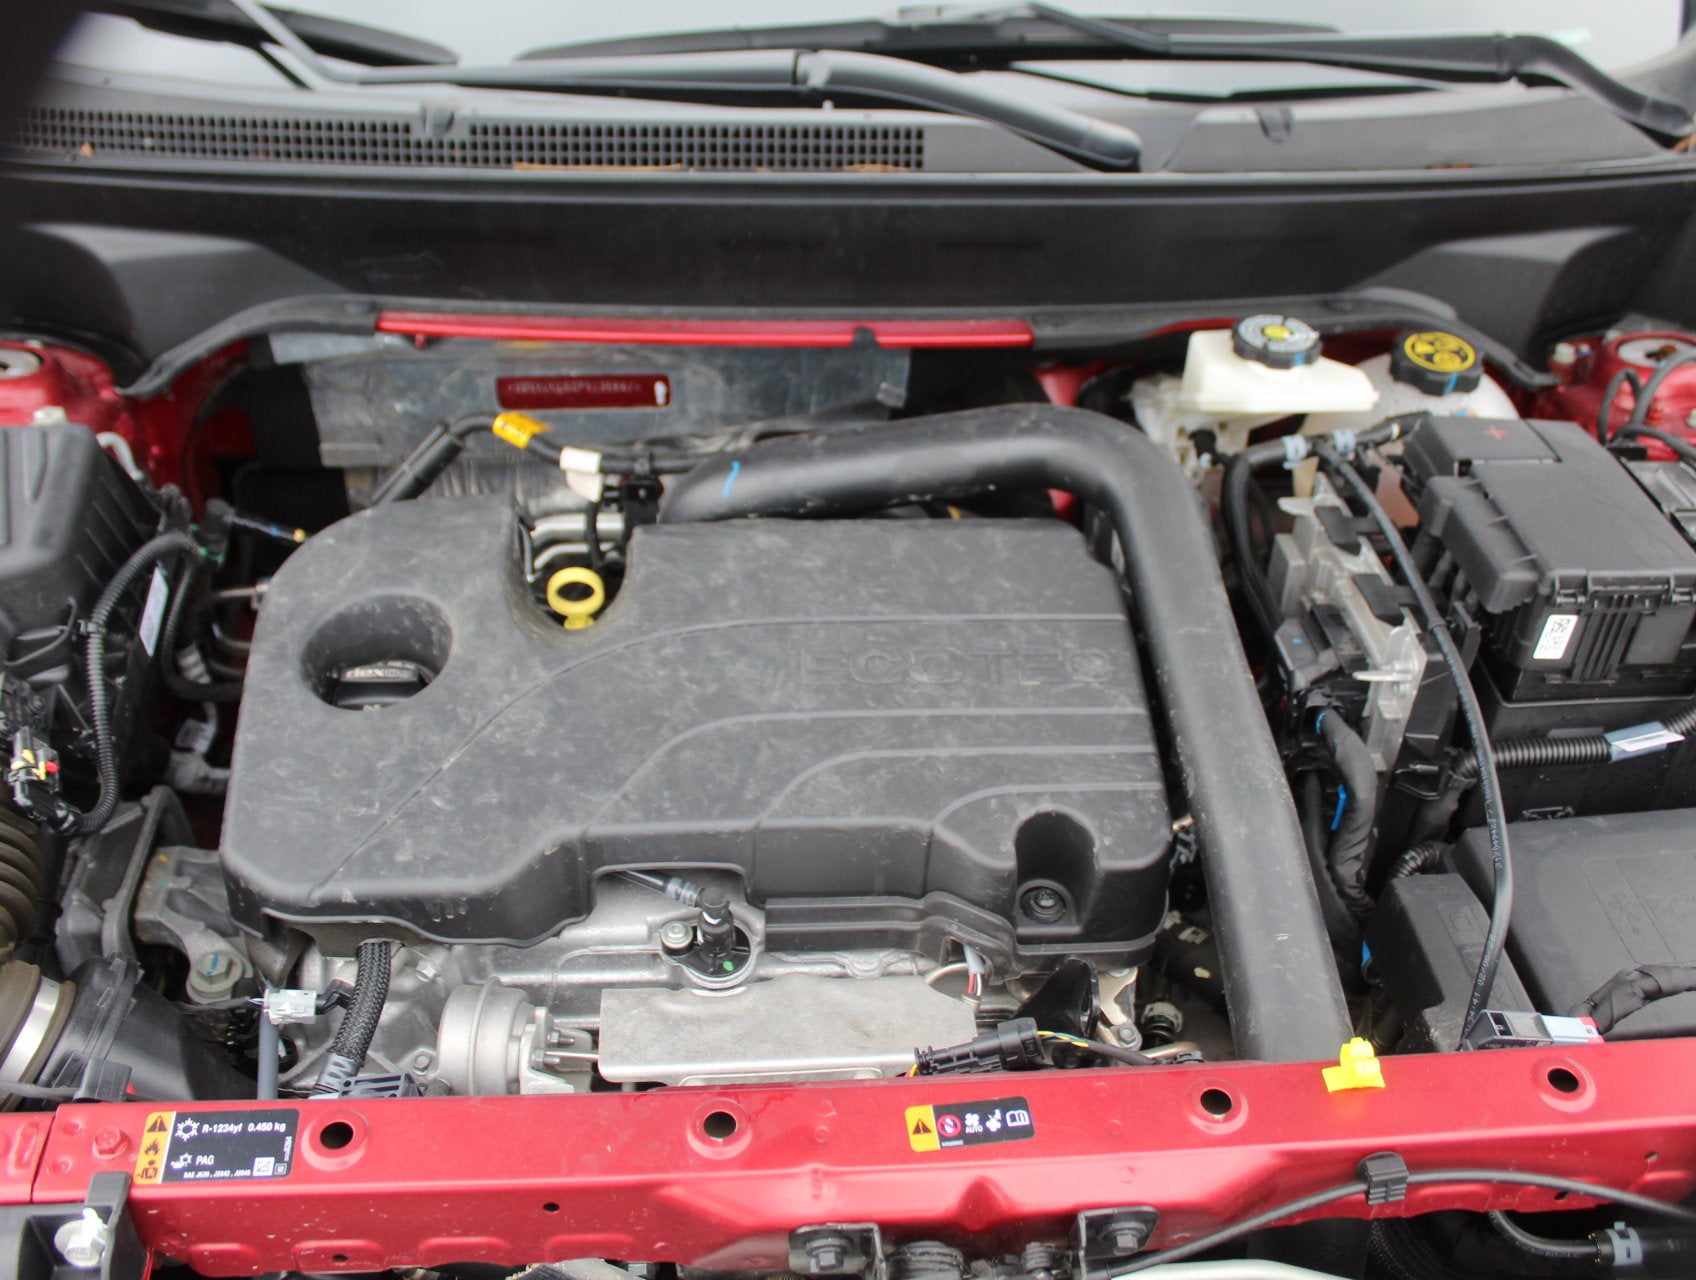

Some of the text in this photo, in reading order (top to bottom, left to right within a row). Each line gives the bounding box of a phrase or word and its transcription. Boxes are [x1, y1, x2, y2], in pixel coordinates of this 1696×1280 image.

[801, 648, 1117, 684] ECOTEC
[202, 1122, 286, 1134] R-1234yf 0.450 kg
[965, 1125, 984, 1134] AUTO
[196, 1155, 215, 1165] PAG
[183, 1171, 195, 1179] SAE
